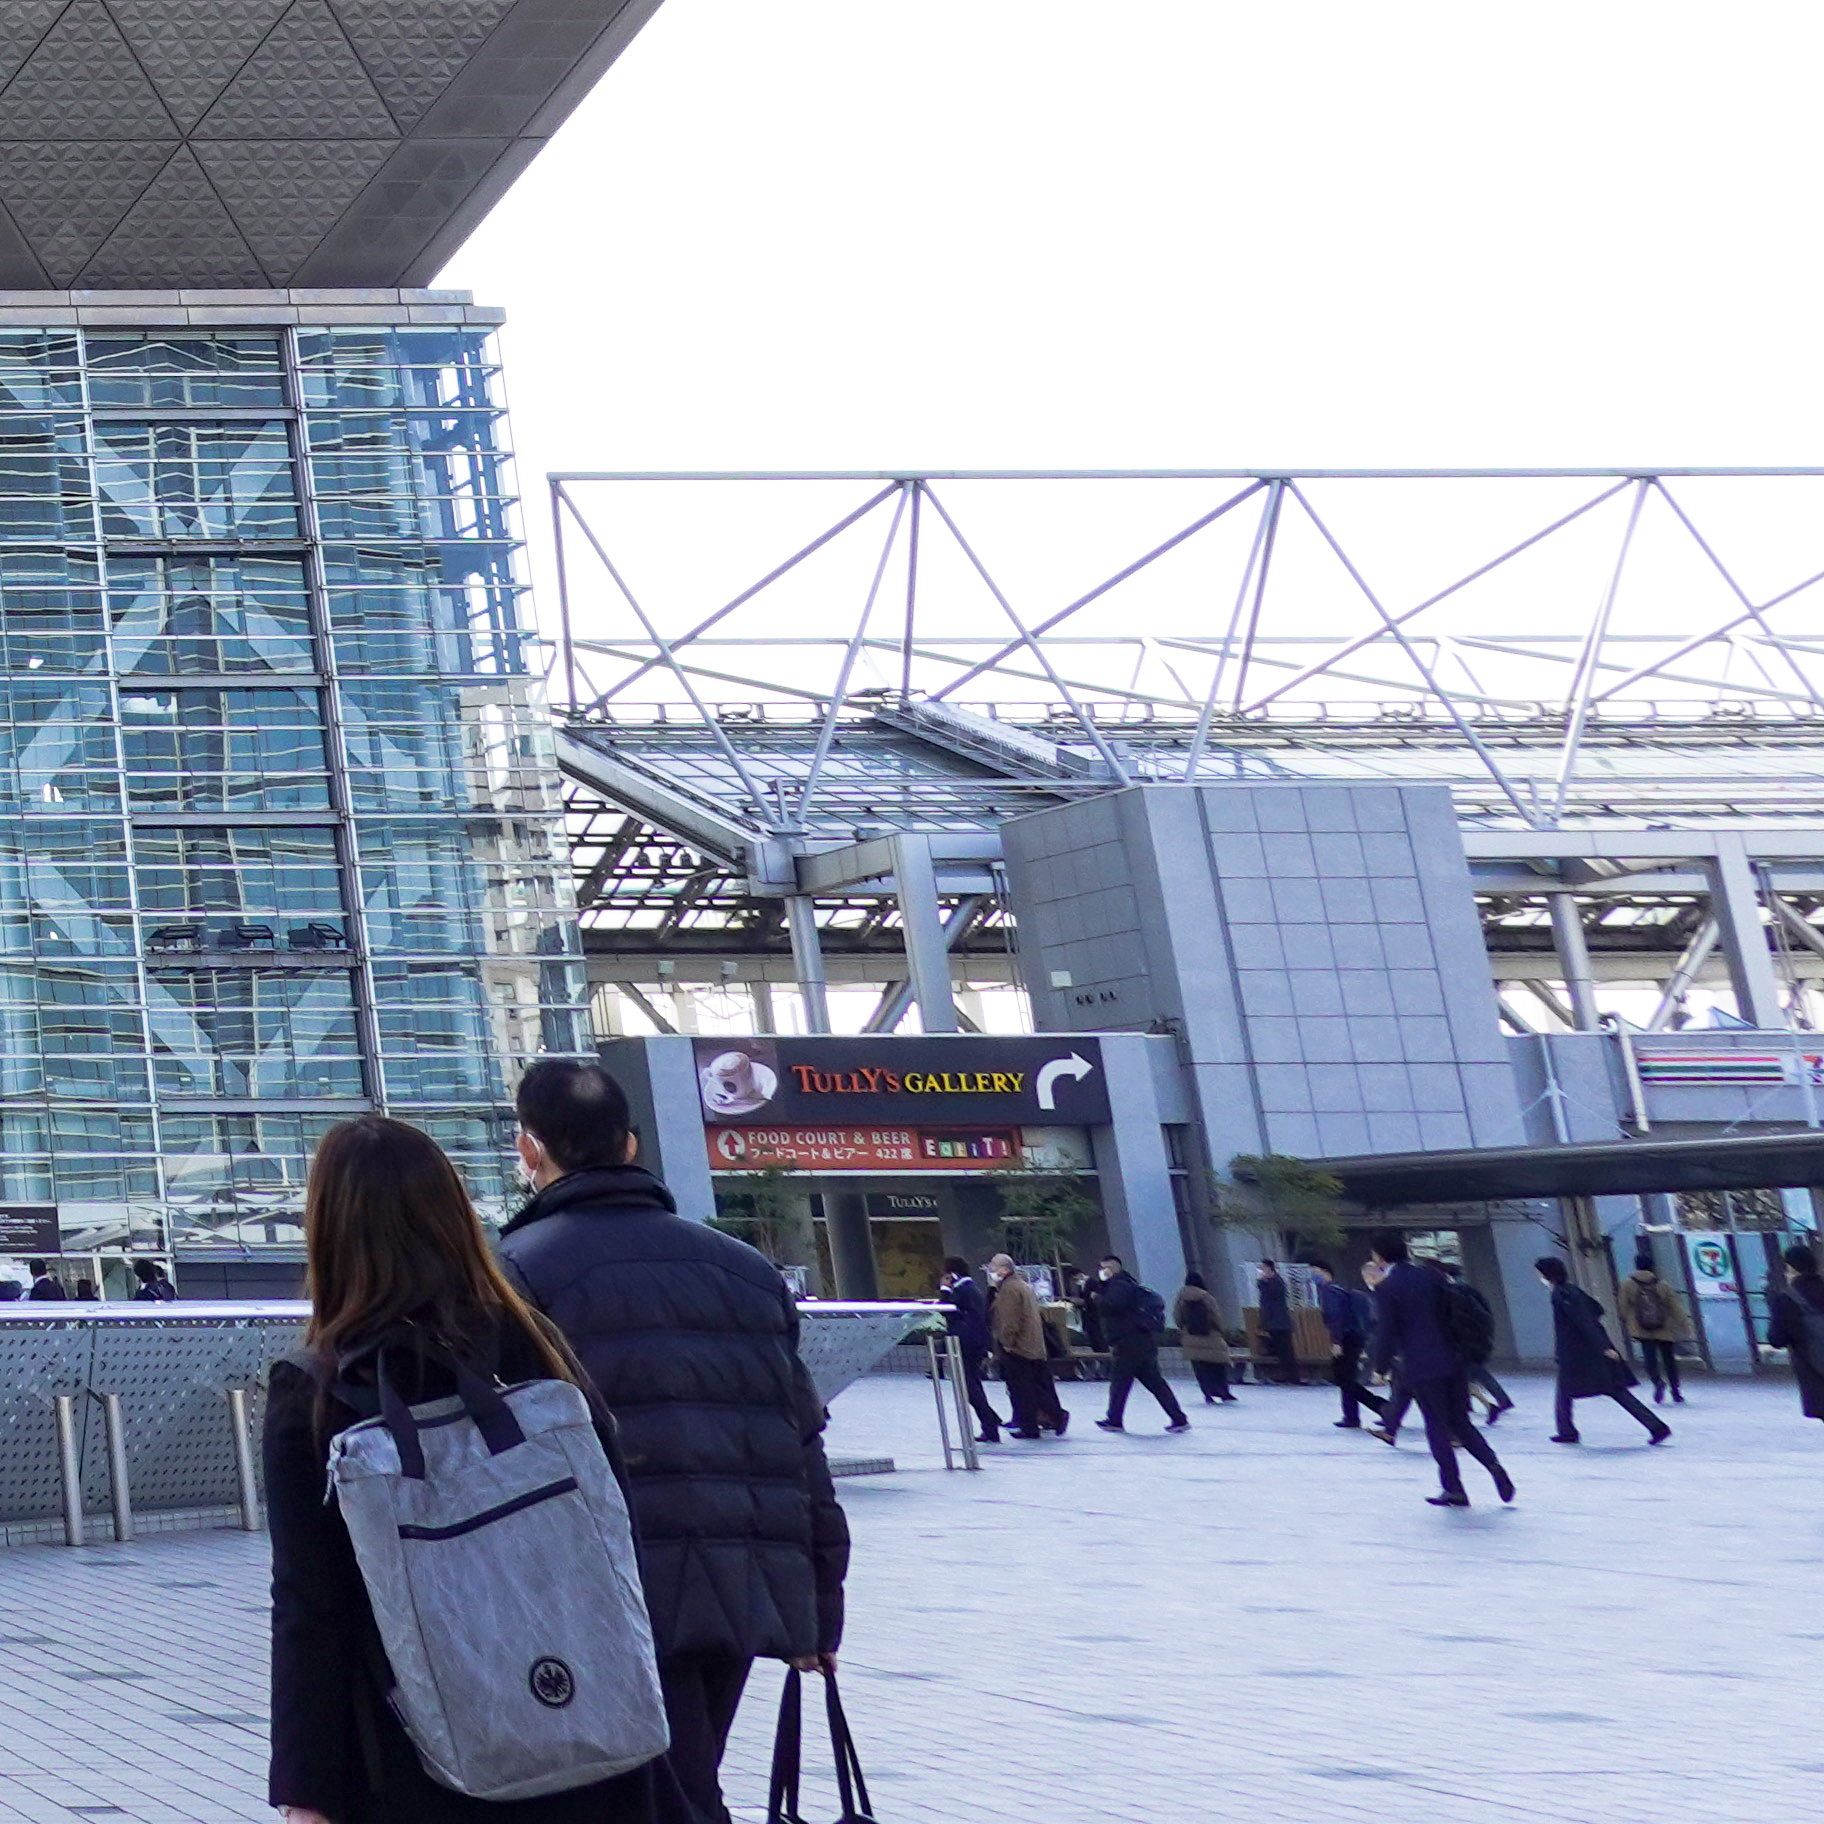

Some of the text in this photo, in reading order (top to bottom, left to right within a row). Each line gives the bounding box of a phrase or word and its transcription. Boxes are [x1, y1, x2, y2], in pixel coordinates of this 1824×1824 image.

[904, 1072, 1025, 1094] GALLERY
[748, 1131, 912, 1145] FOOD COURT & BEER
